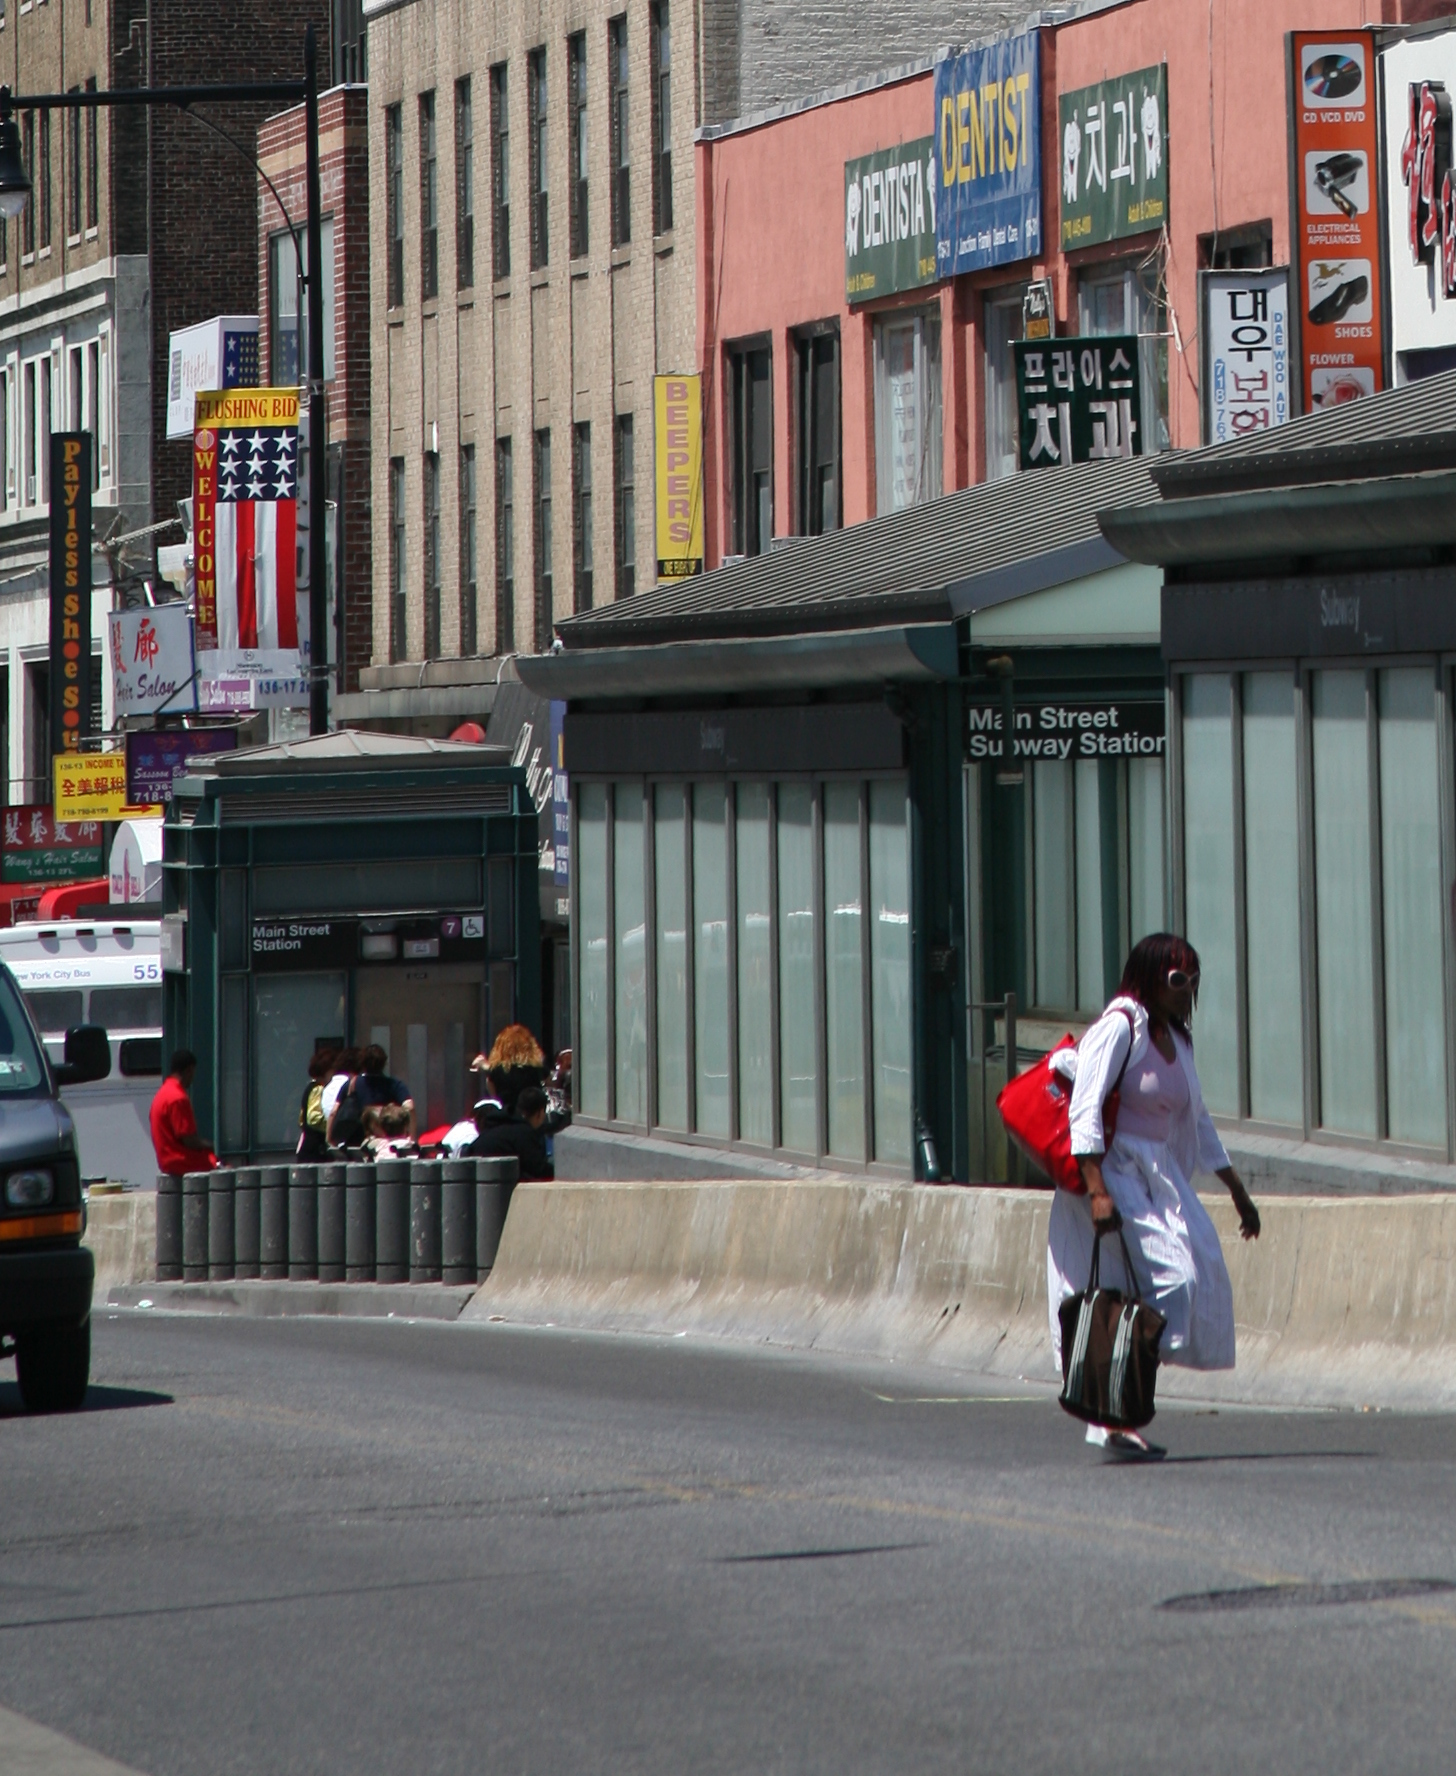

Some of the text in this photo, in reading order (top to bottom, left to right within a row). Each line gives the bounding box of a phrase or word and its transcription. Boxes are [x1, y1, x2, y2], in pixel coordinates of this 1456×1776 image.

[1304, 111, 1365, 123] CD VCD DVD
[942, 73, 1029, 188] DENTIST
[1085, 92, 1137, 193] 치과
[863, 159, 925, 250] DENTISTA
[1307, 223, 1361, 234] ELECTRICAL
[1308, 234, 1362, 245] APPLIANCES
[1274, 312, 1284, 345] DAE
[1335, 326, 1373, 338] SHOES
[1024, 348, 1134, 393] 프라이스
[1273, 350, 1285, 383] WOO
[1310, 354, 1354, 365] FLOWER
[197, 399, 267, 421] FLUSHING
[272, 398, 297, 418] BID
[1028, 398, 1137, 465] 치과
[666, 382, 690, 543] BEEPERS
[63, 441, 81, 586] Payless
[195, 452, 215, 624] WELCOME
[1321, 588, 1360, 634] Subway
[137, 673, 177, 700] Salon
[259, 681, 296, 695] 136-17
[1040, 706, 1119, 729] Street
[970, 734, 1073, 760] Suway
[85, 759, 114, 769] INCOME
[44, 853, 67, 865] Hair
[71, 849, 99, 864] Salon
[253, 923, 330, 939] Main Street
[446, 922, 456, 934] 7
[253, 938, 301, 952] Station
[14, 969, 91, 982] ew York City Bus
[133, 964, 163, 980] 55
